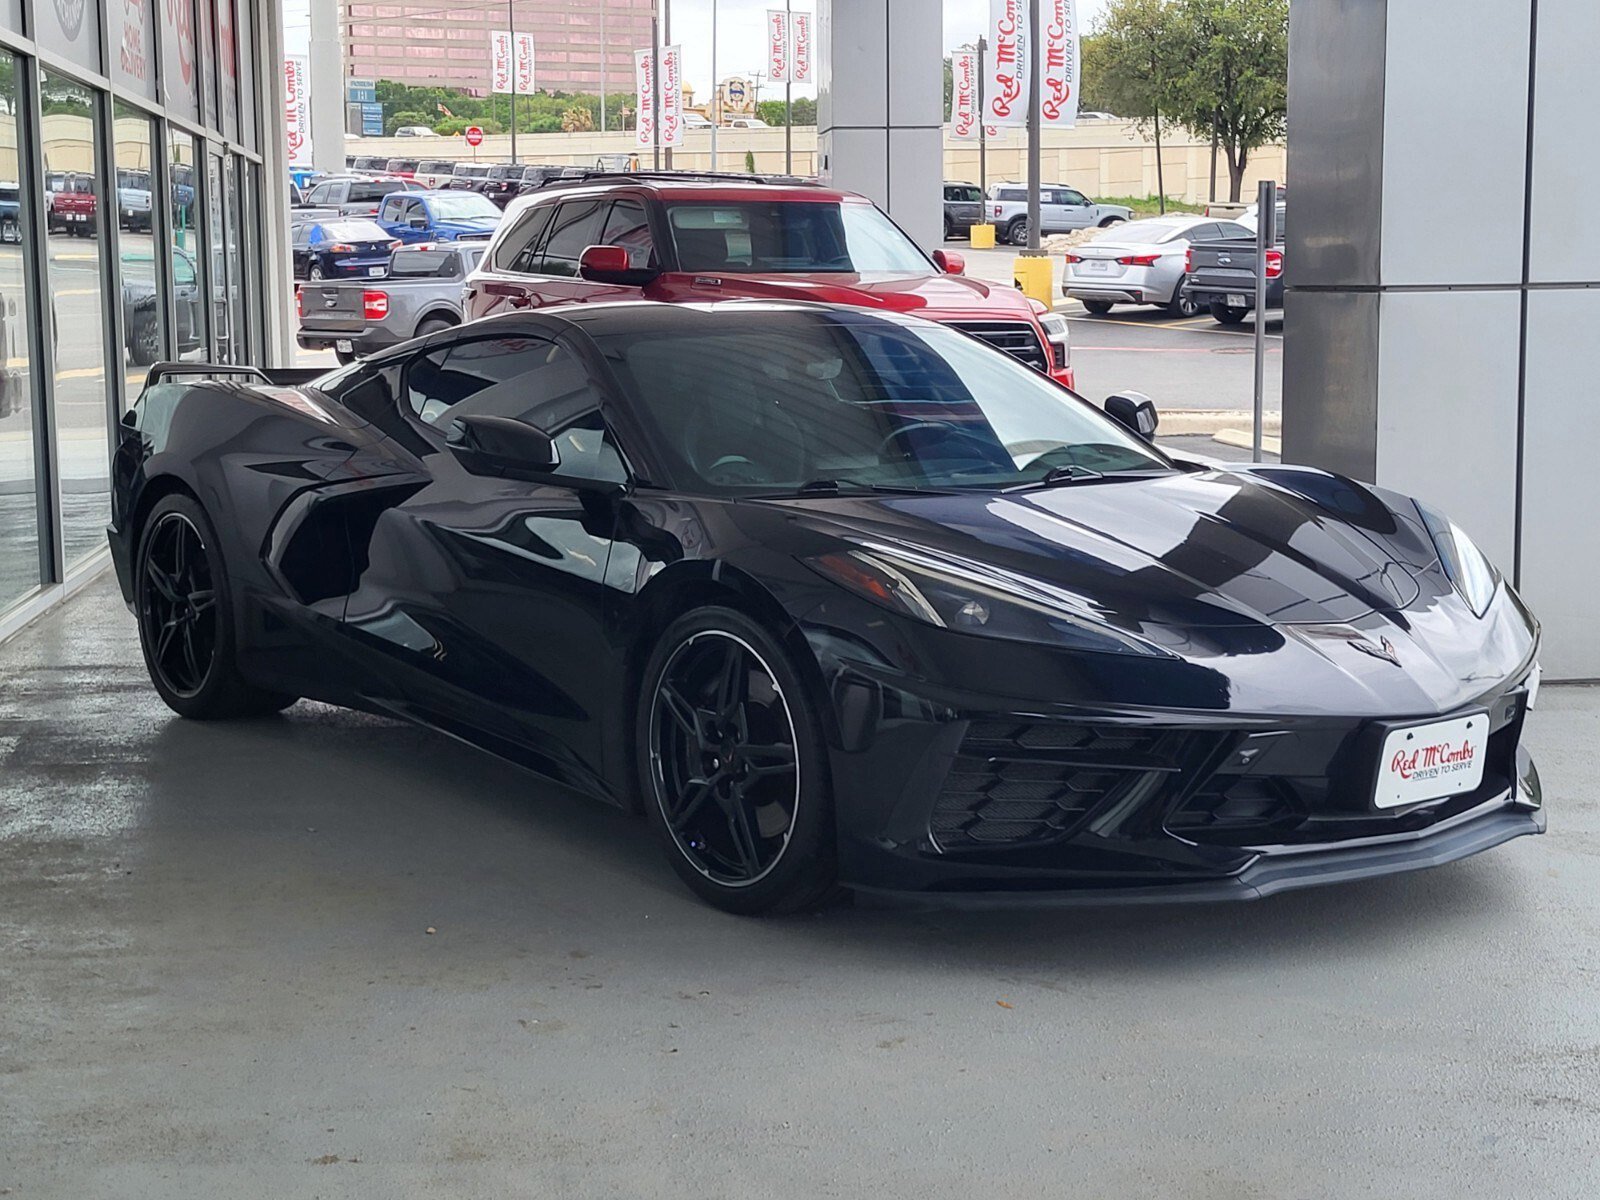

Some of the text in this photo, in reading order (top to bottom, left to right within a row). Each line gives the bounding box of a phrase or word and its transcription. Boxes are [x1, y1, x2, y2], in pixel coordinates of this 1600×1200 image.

[797, 16, 806, 56] McCombs
[996, 0, 1015, 70] McCom
[1016, 14, 1023, 29] TO
[1065, 19, 1072, 34] TO
[496, 35, 505, 70] McCombs
[519, 37, 531, 91] Red McCombs
[772, 14, 785, 78] Red McCombs
[1016, 34, 1024, 80] DRIVEN
[1042, 0, 1069, 120] Red McCom
[496, 73, 508, 90] Red
[640, 55, 651, 114] McCombs
[796, 60, 808, 79] Red
[297, 87, 304, 102] TO
[664, 52, 678, 142] Red McCombs
[955, 55, 974, 136] Red McCombs
[992, 74, 1020, 117] Red
[639, 118, 654, 143] Red
[1391, 740, 1474, 779] Red McCombs
[1412, 760, 1473, 780] DRIVEN TO SERVE
